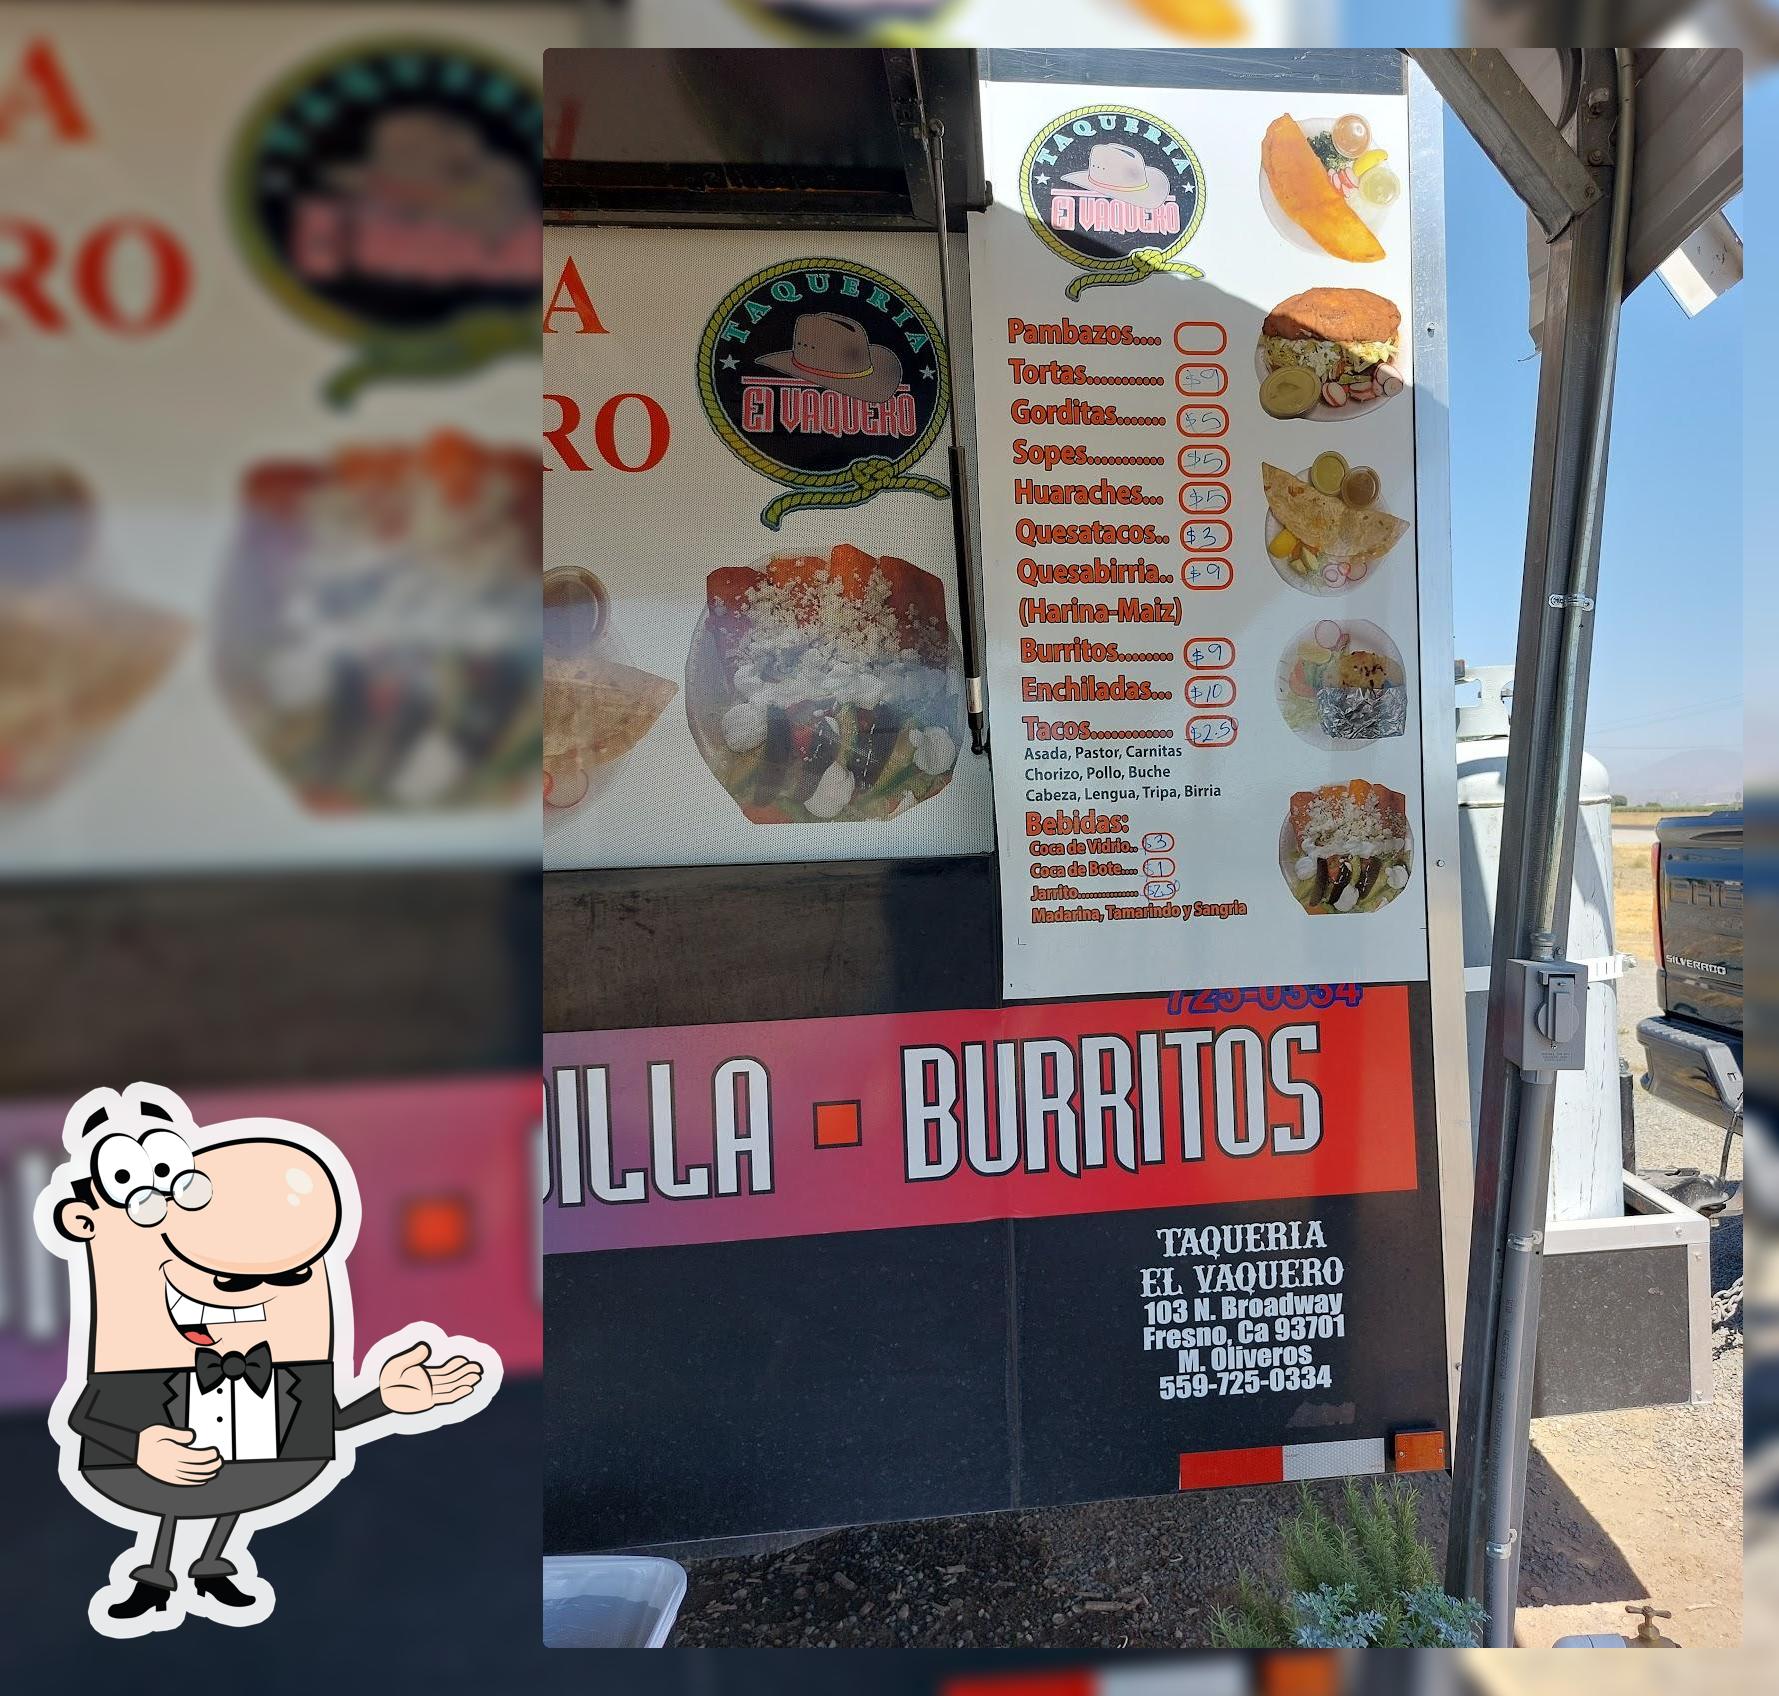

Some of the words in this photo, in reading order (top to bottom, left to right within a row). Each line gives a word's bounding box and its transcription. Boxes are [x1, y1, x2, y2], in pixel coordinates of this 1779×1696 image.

[1035, 115, 1191, 175] TAQUERIA
[720, 273, 933, 354] TAQUERIA
[1185, 412, 1222, 433] $5
[1185, 450, 1223, 474] $5
[1188, 488, 1227, 512] $5
[1186, 526, 1217, 549] $3
[1187, 563, 1221, 583] $9
[1019, 597, 1183, 627] (Harina-Maiz)
[1191, 643, 1223, 666] $9
[1189, 682, 1223, 703] $10
[1024, 747, 1072, 761] Asada,
[1075, 746, 1122, 760] Pastor,
[1126, 745, 1183, 758] Carnitas
[1025, 768, 1083, 782] Chorizo,
[1087, 766, 1125, 780] Pollo,
[1128, 765, 1171, 779] Buche
[1026, 788, 1081, 802] Cabeza,
[1085, 787, 1140, 801] Lengua,
[1142, 786, 1181, 800] Tripa,
[1185, 784, 1221, 798] Birria
[1025, 809, 1130, 836] Bebidas:
[1029, 841, 1065, 857] Coca
[1066, 839, 1086, 855] de
[1030, 862, 1066, 878] Coca
[1067, 860, 1087, 877] de
[1032, 905, 1104, 923] Madarina,
[1105, 902, 1181, 920] Tamarindo
[1182, 905, 1193, 921] y
[1194, 900, 1248, 919] Sangria
[1666, 954, 1727, 976] SILVERADO
[901, 1021, 1323, 1183] BURRITOS
[1156, 1220, 1328, 1259] TAQUERIA
[1140, 1267, 1183, 1297] EL
[1193, 1256, 1345, 1295] VAQUERO
[1143, 1300, 1188, 1325] 103
[1194, 1298, 1216, 1321] N.
[1221, 1292, 1343, 1320] Broadway
[1143, 1326, 1233, 1350] Fresno,
[1237, 1320, 1269, 1344] Ca
[1274, 1314, 1346, 1341] 93701
[1178, 1350, 1206, 1374] M.
[1211, 1344, 1313, 1370] Oliveros
[1159, 1364, 1333, 1400] 559-725-0334
